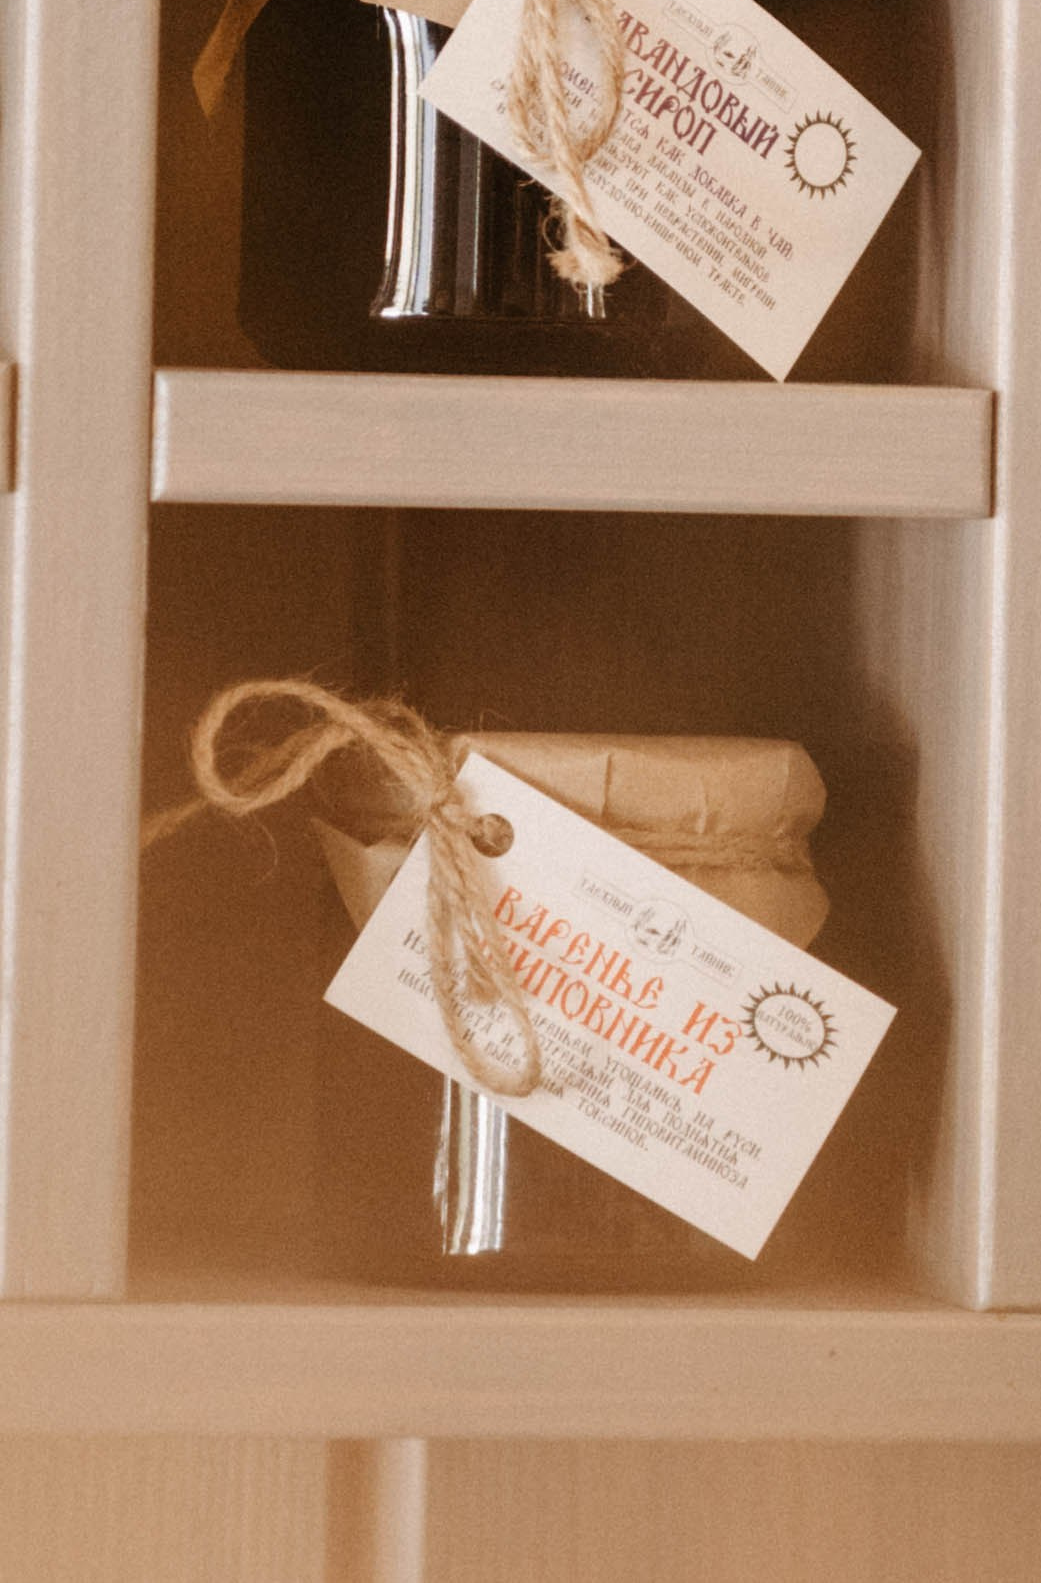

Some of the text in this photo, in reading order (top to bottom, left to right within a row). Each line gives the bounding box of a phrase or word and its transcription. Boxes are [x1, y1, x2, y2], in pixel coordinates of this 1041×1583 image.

[606, 8, 785, 158] АВАНДОВЫЙ
[615, 63, 721, 155] СИРОП
[653, 135, 687, 167] КАК
[484, 935, 718, 1096] ИПОВНИКА
[489, 884, 746, 1060] ВАРЕНЬЕ ИЗ
